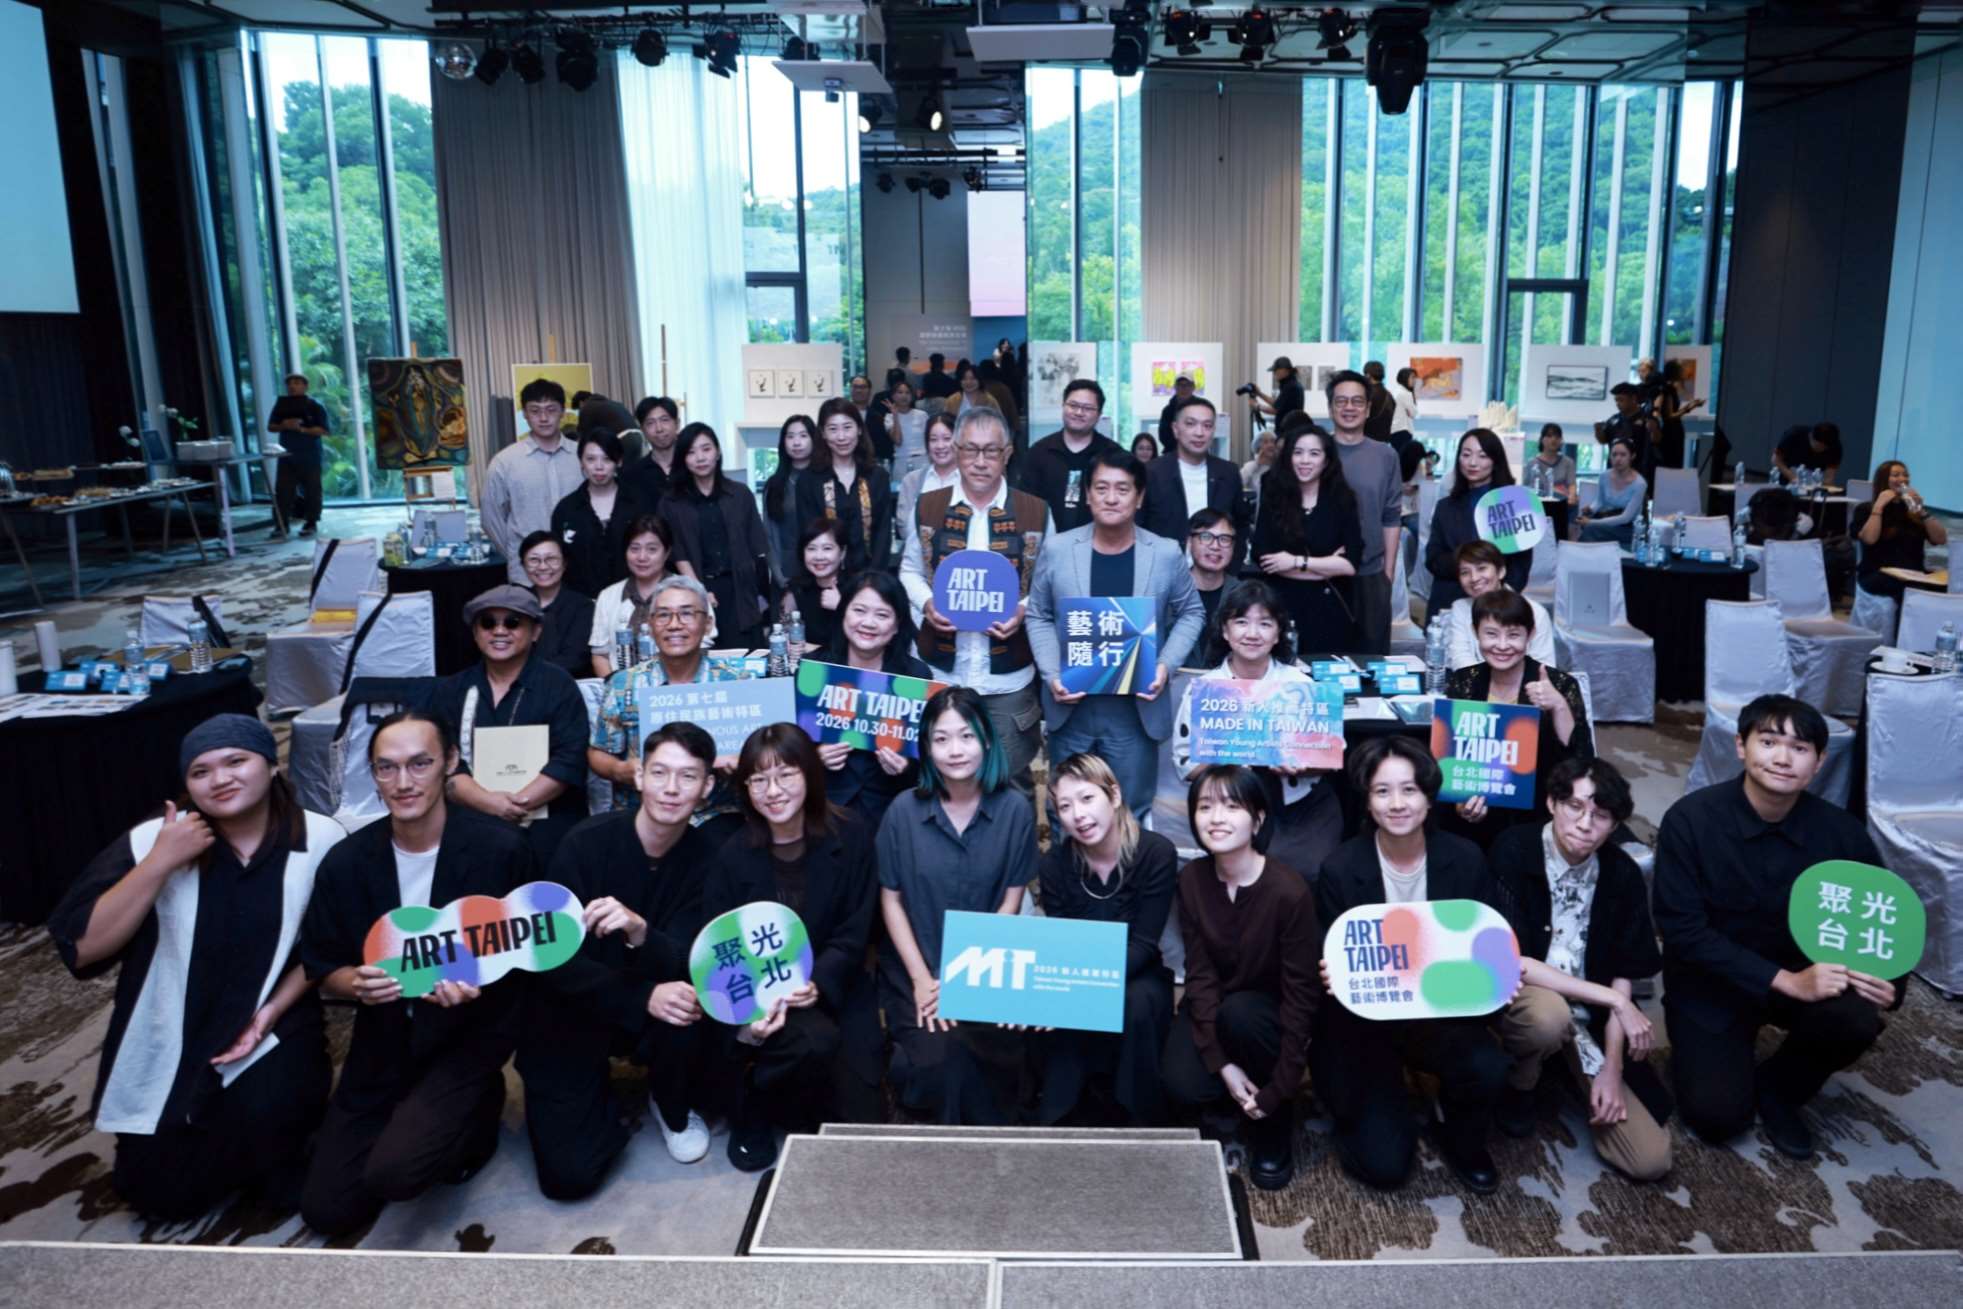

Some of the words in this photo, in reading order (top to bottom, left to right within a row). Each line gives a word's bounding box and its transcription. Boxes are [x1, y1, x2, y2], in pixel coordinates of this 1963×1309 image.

[1488, 500, 1515, 523] ART
[1488, 514, 1536, 539] TAIPEI
[947, 568, 988, 590] ART
[946, 589, 1004, 613] TAIPEI
[1067, 610, 1125, 636] 藝術
[1067, 641, 1124, 667] 隨行
[649, 694, 683, 708] 2026
[816, 684, 862, 713] ART
[1200, 699, 1238, 712] 2026
[816, 712, 850, 730] 2026
[1200, 717, 1244, 731] MADE
[1247, 719, 1263, 731] IN
[1268, 720, 1329, 734] TAIWAN
[1455, 711, 1501, 738] ART
[1453, 736, 1518, 766] TAIPEI
[1452, 766, 1504, 780] 台北國際
[1818, 881, 1897, 925] 聚光
[400, 929, 458, 973] ART
[464, 910, 556, 958] TAIPEI
[1344, 919, 1384, 946] ART
[1817, 918, 1894, 960] 台北
[713, 922, 784, 970] 聚光
[1344, 943, 1410, 973] TAIPEI
[725, 956, 793, 1005] 台北
[1348, 976, 1400, 990] 台北國際
[1350, 990, 1414, 1005] 藝術博覽會
